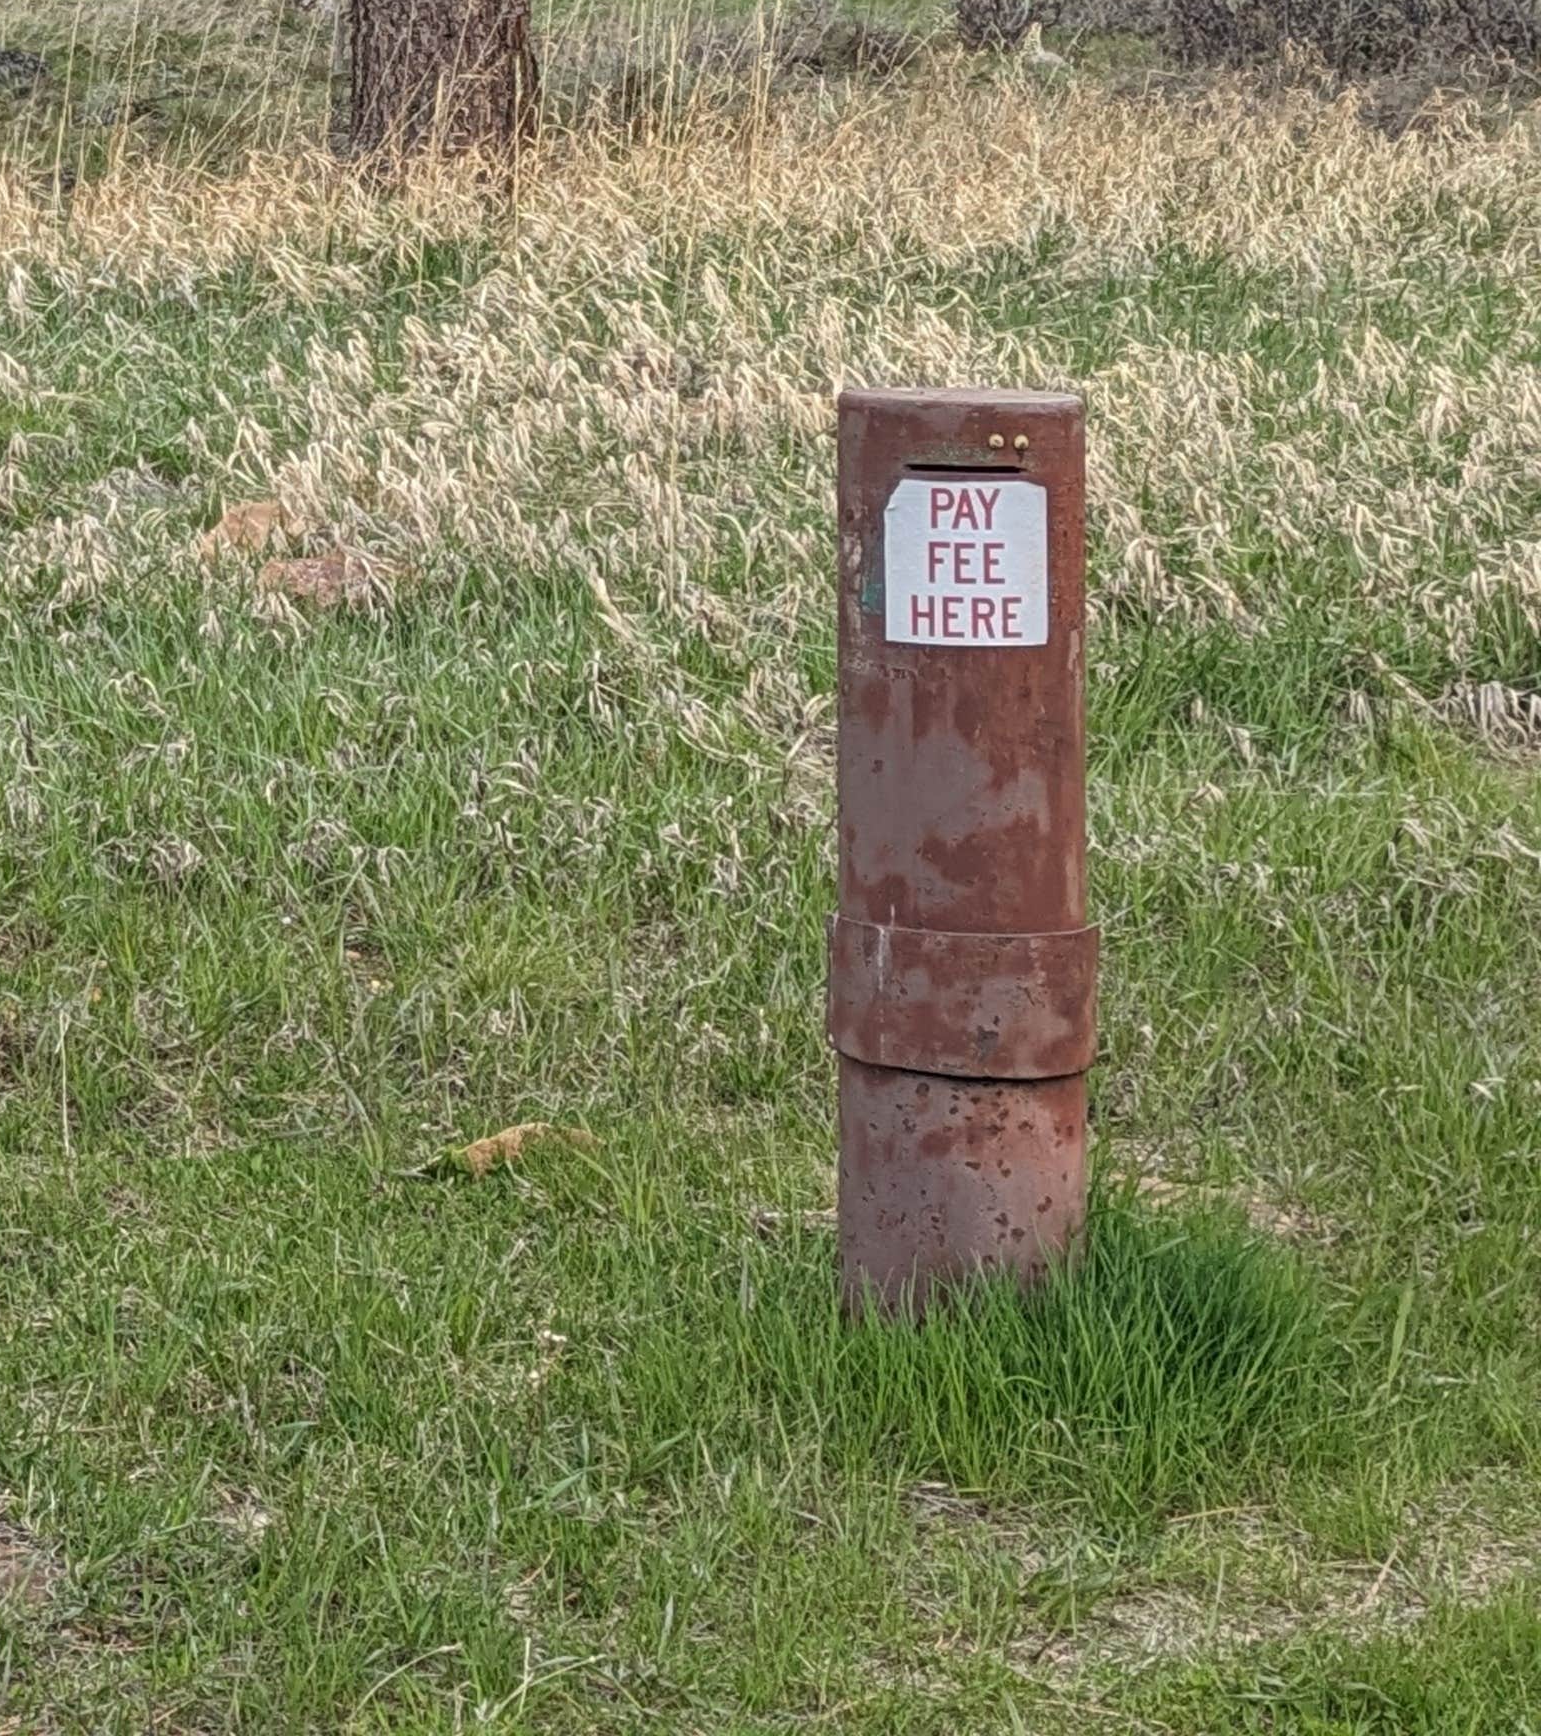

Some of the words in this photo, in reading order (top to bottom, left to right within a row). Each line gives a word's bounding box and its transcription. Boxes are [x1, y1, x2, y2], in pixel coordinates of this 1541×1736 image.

[930, 487, 1002, 531] PAY
[928, 541, 1006, 585] FEE
[910, 594, 1024, 640] HERE
